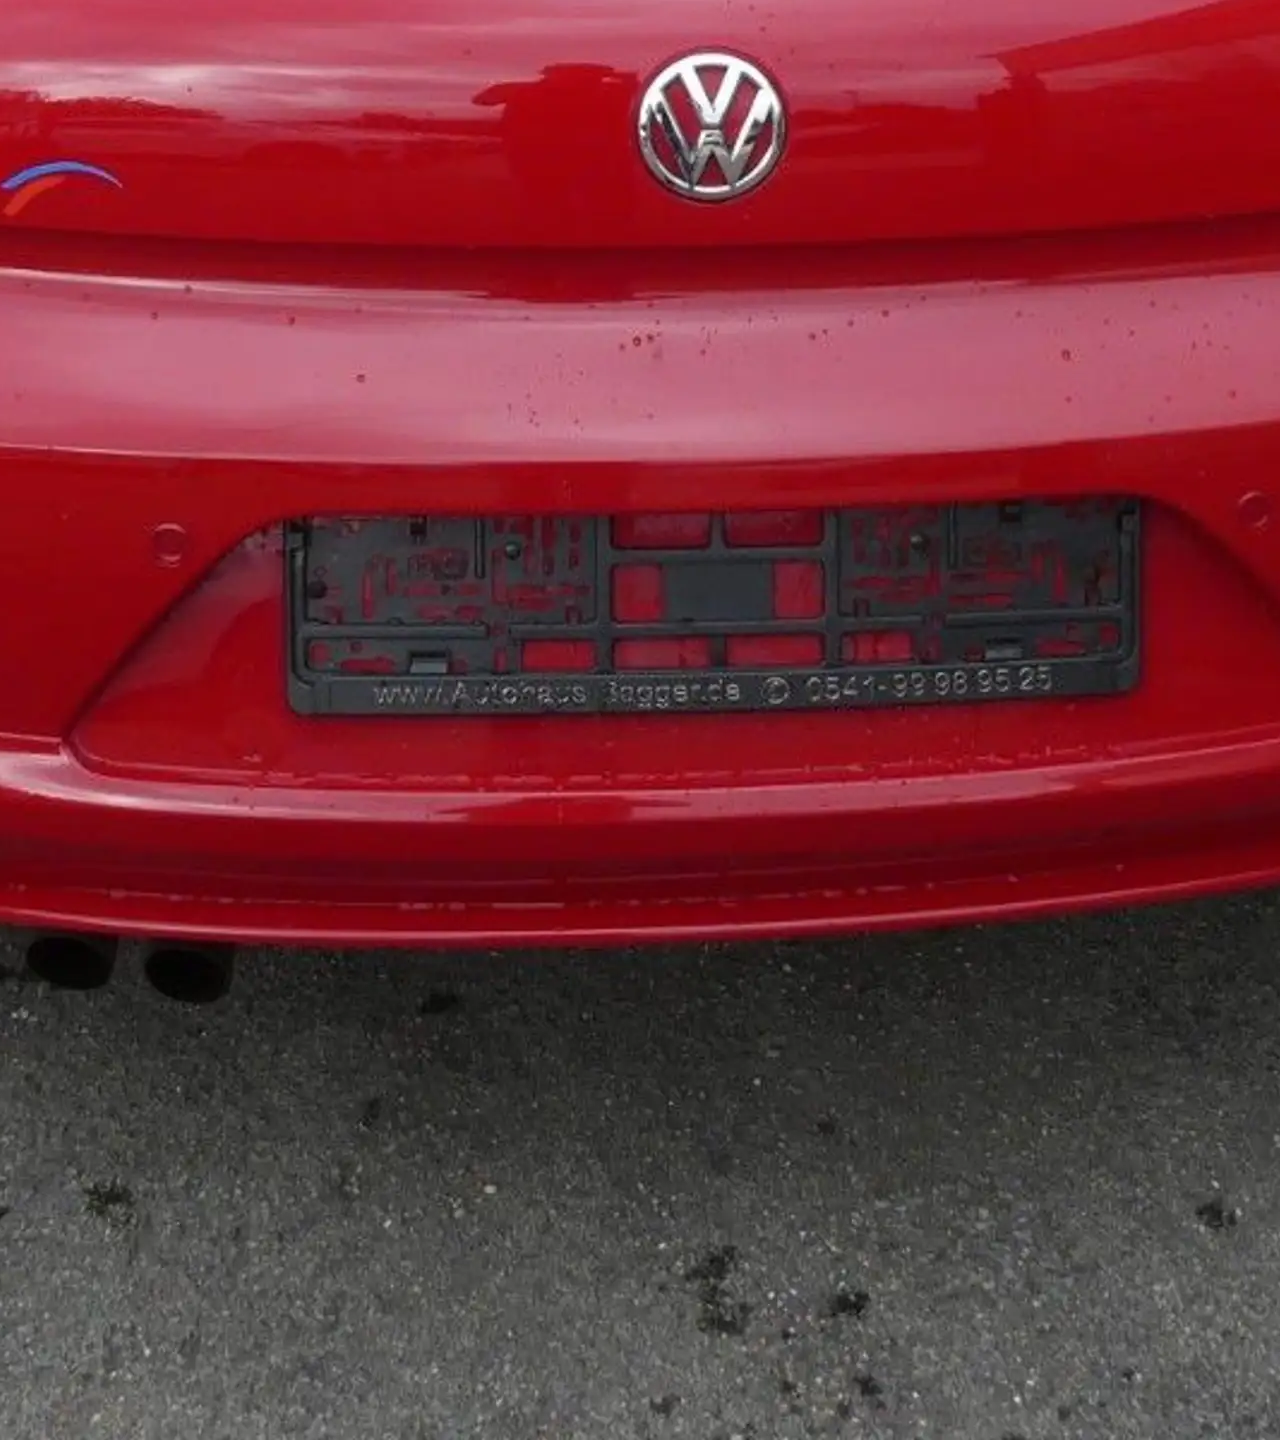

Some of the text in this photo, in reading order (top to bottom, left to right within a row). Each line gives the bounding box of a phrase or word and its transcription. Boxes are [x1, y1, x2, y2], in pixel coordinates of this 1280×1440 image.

[934, 671, 970, 696] 98
[977, 669, 1011, 693] 95
[1019, 667, 1053, 691] 25
